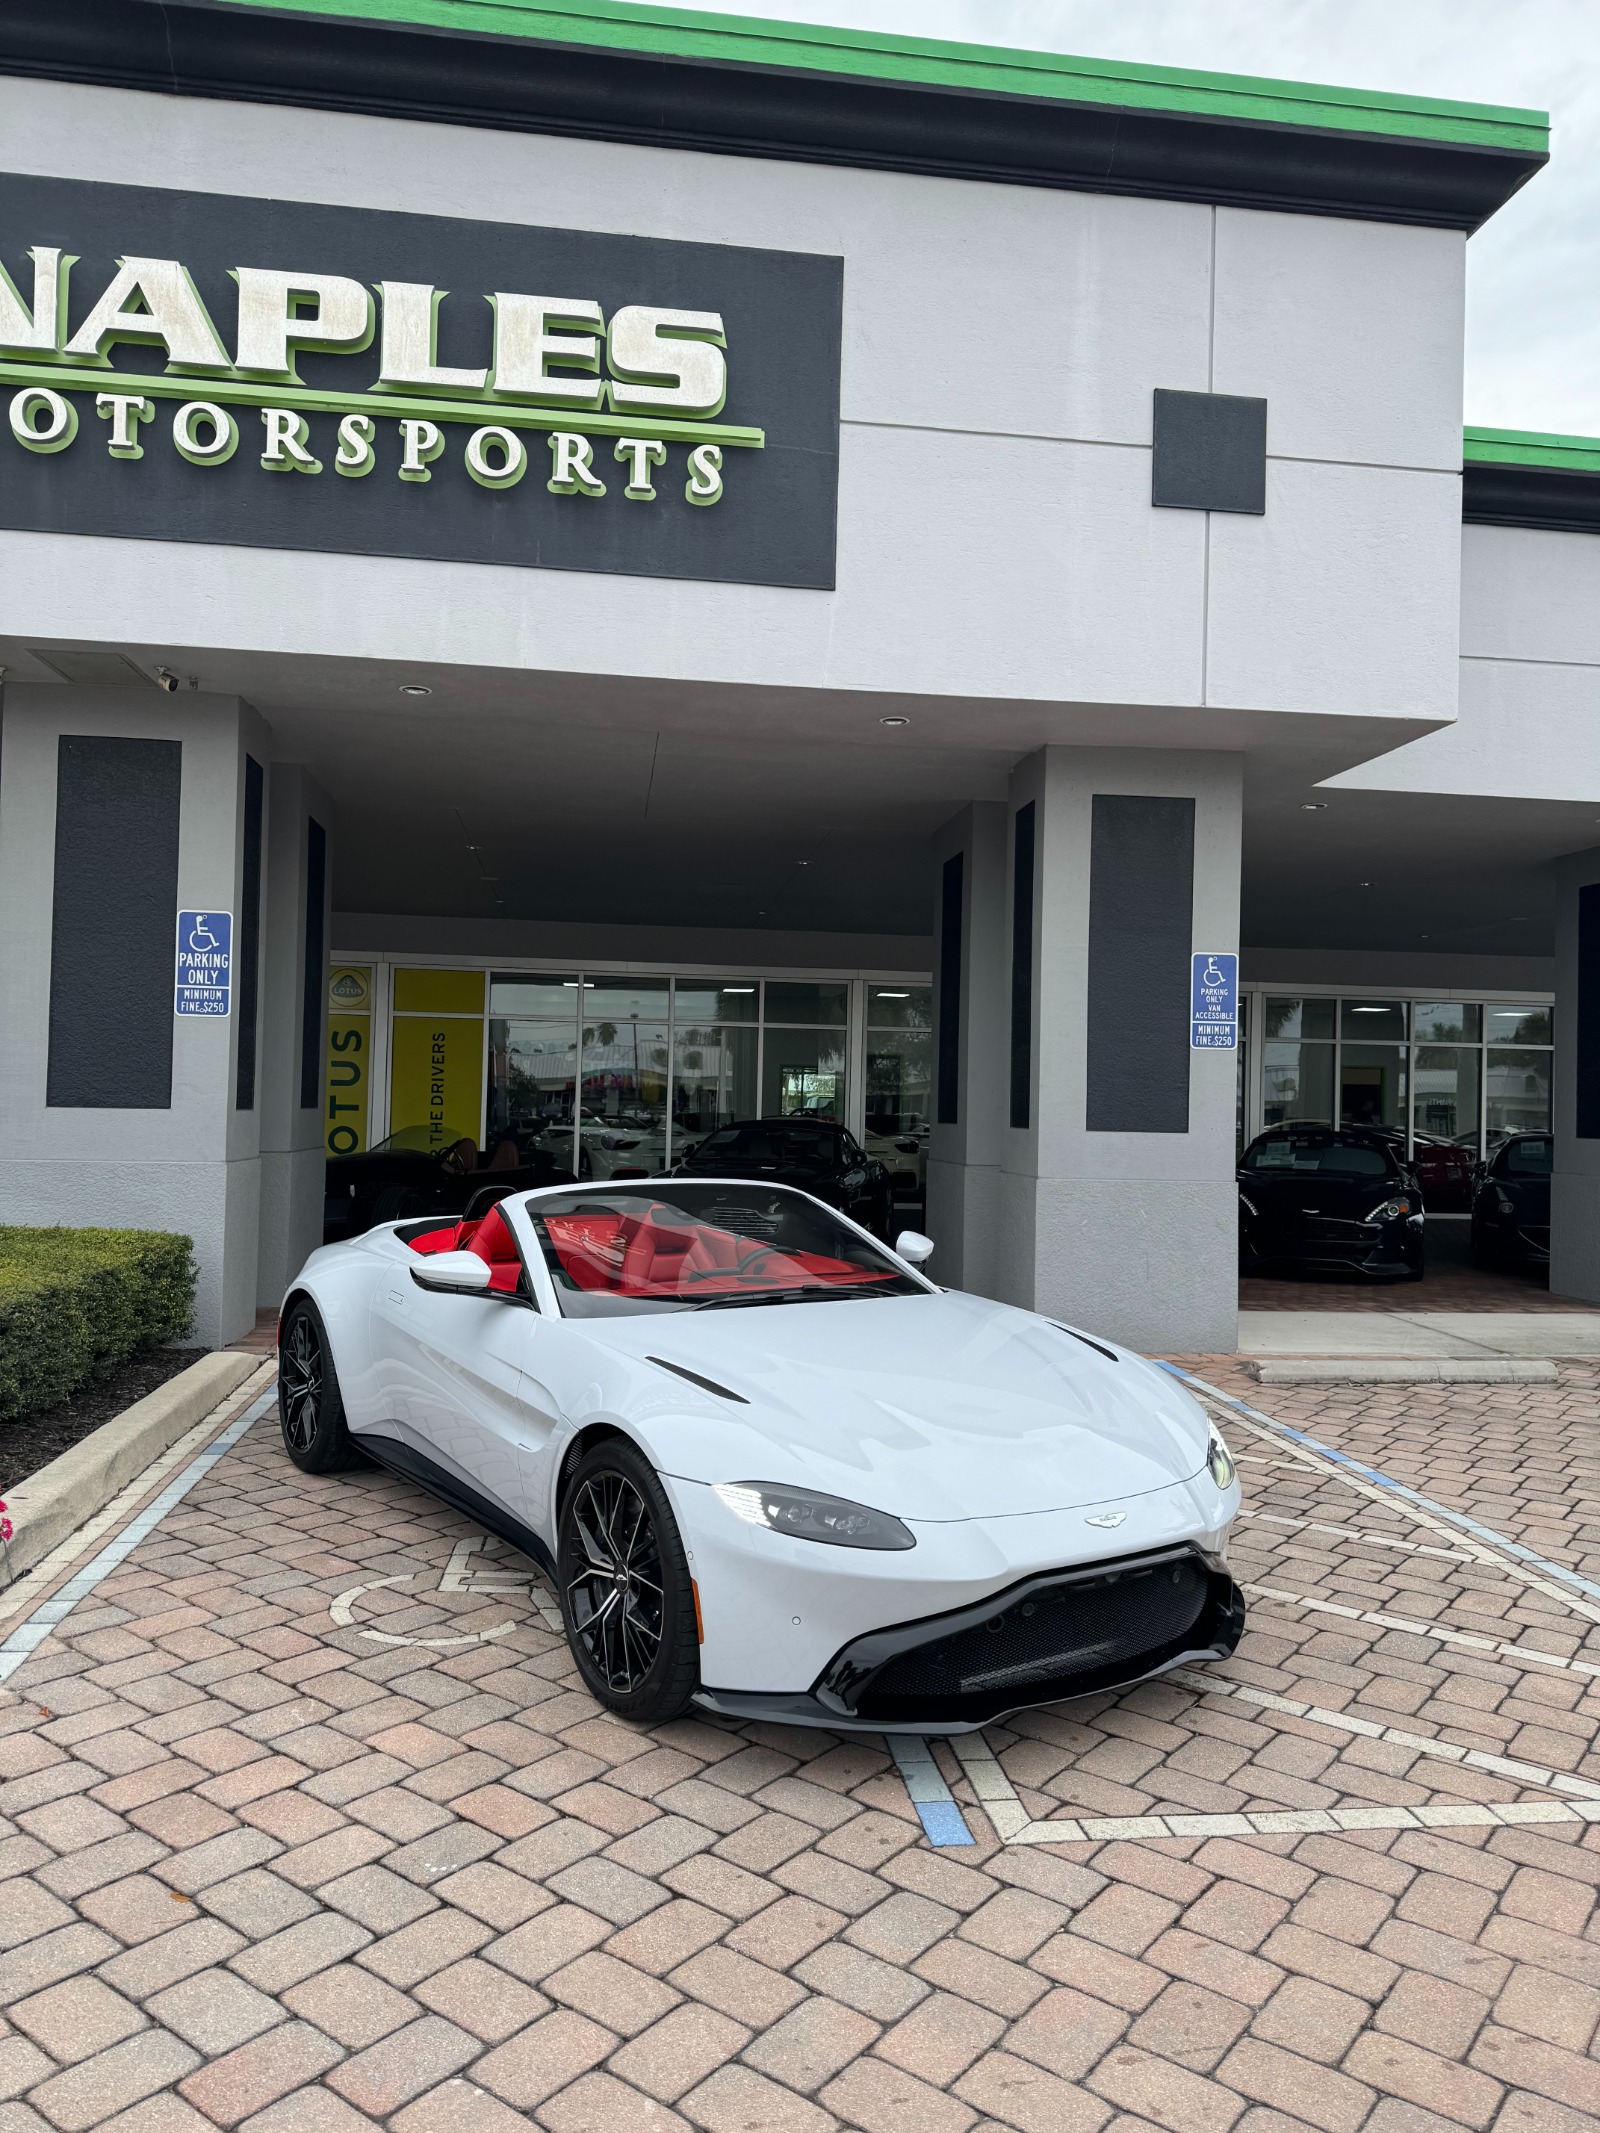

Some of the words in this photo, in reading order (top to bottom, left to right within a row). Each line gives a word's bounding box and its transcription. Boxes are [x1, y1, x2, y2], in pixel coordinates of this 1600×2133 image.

[9, 387, 724, 505] OTORSPORTS
[179, 952, 229, 968] PARKING
[188, 969, 218, 984] ONLY
[184, 989, 222, 1000] MINIMUM
[334, 987, 362, 995] LOTUS
[1200, 988, 1228, 996] PARKING
[181, 1001, 200, 1012] FINE
[203, 1002, 224, 1013] $250
[1208, 1004, 1221, 1012] VAN
[1195, 1012, 1234, 1020] ACCESSIBLE
[1198, 1025, 1230, 1035] MINIMUM
[1195, 1036, 1212, 1045] FINE
[1214, 1036, 1232, 1046] $250
[431, 1032, 446, 1106] DRIVERS
[328, 1029, 362, 1154] OTUS
[429, 1111, 443, 1144] THE
